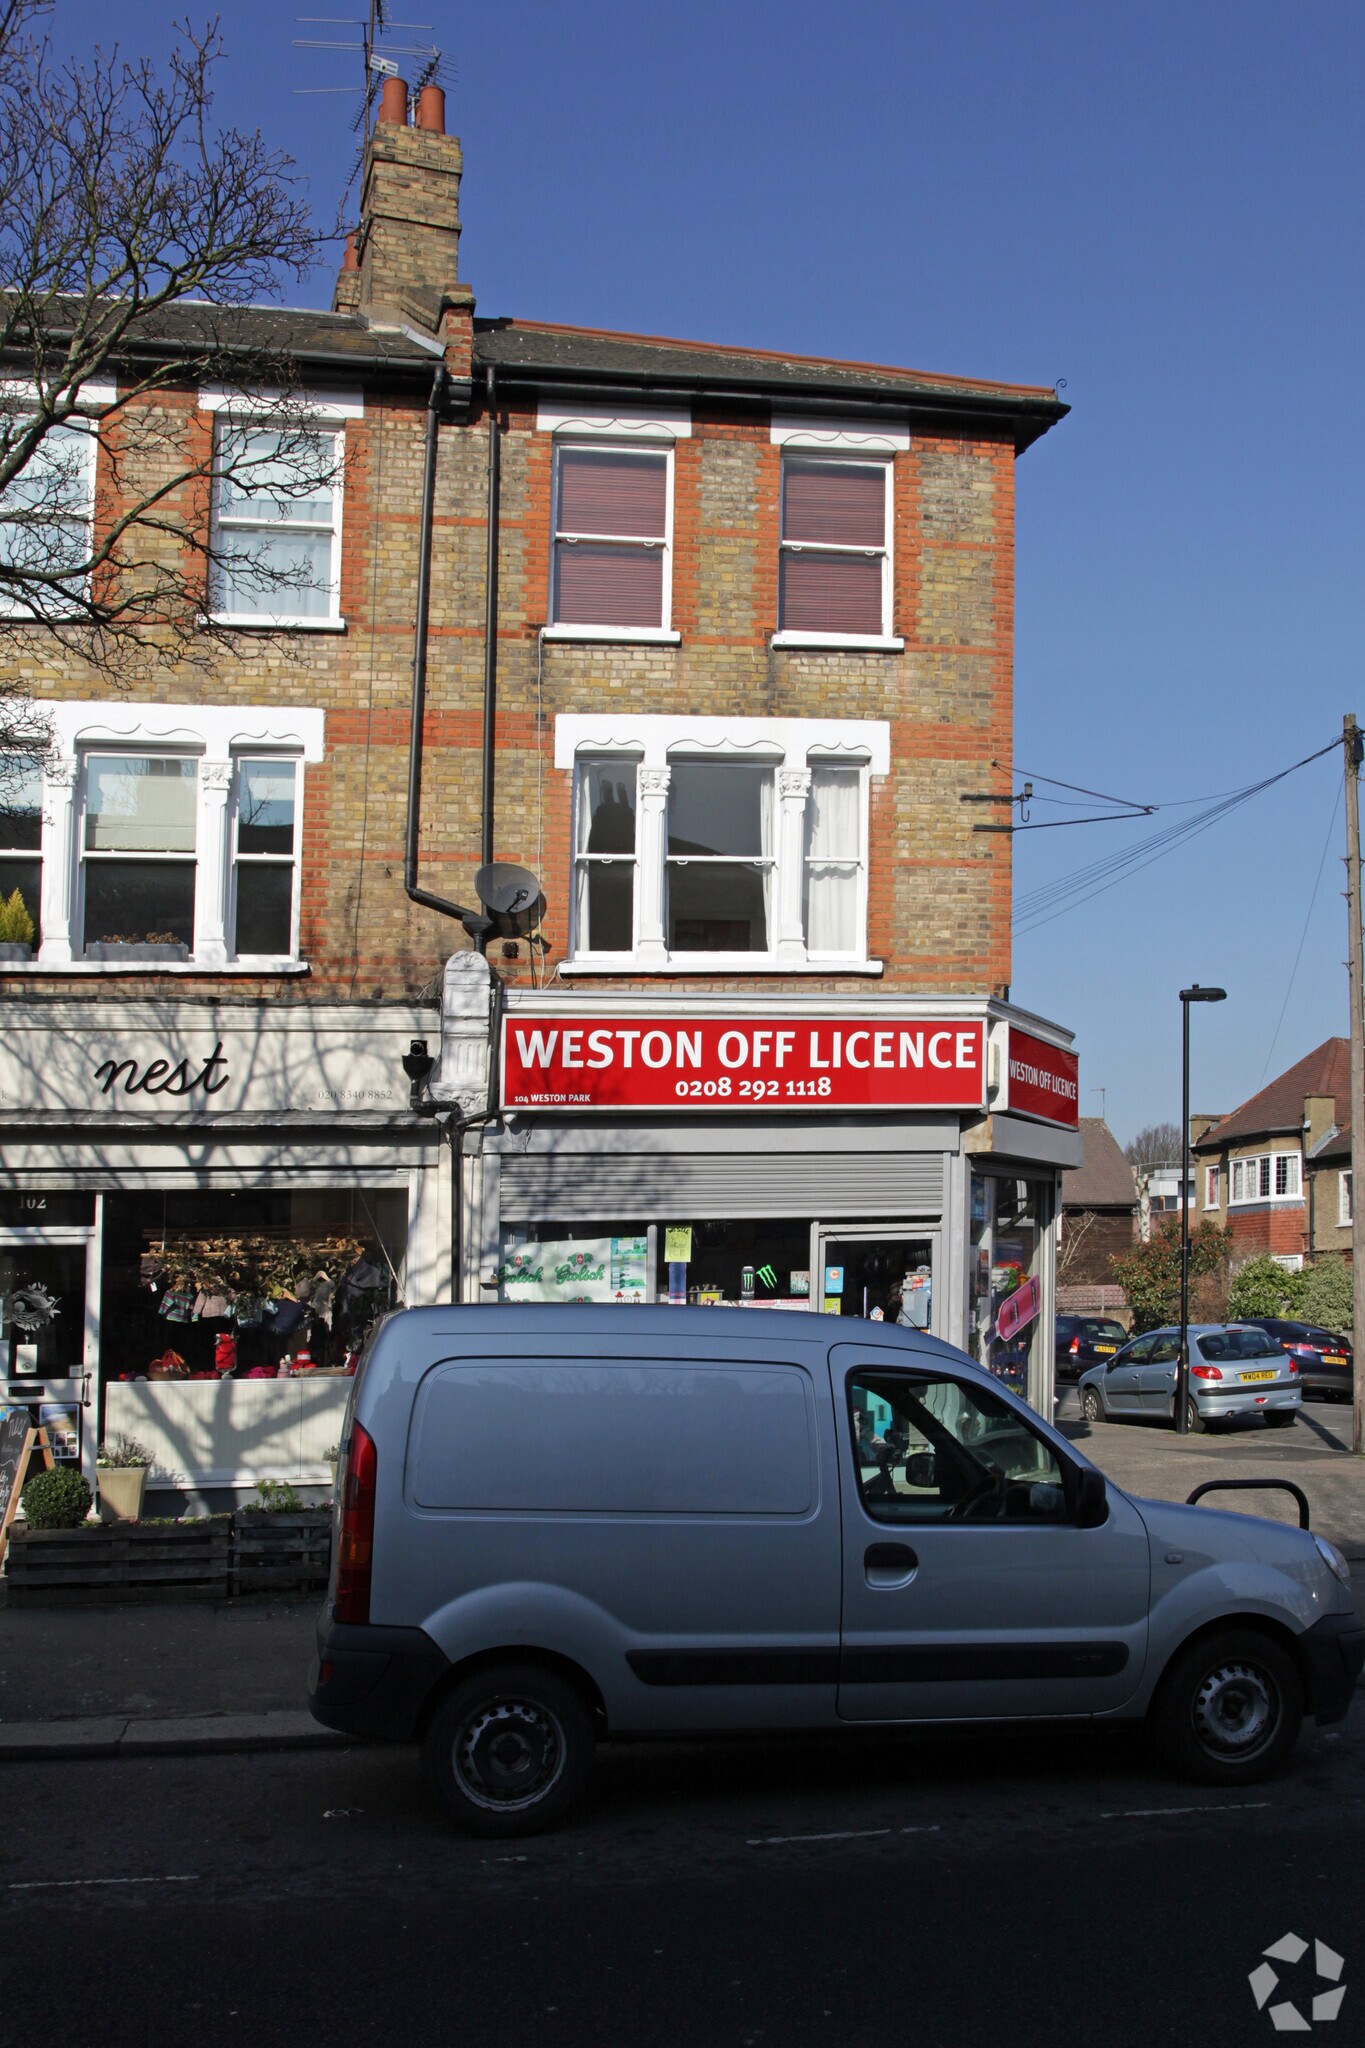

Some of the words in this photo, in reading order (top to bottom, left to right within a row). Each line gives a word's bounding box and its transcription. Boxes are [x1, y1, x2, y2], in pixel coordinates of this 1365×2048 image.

[515, 1030, 702, 1069] WESTON
[717, 1030, 796, 1069] OFF
[809, 1031, 976, 1069] LICENCE
[94, 1041, 230, 1096] nest
[1009, 1058, 1038, 1087] WESTON
[1039, 1070, 1051, 1091] OFF
[1052, 1075, 1077, 1100] LICENCE
[318, 1090, 337, 1100] 020
[340, 1090, 365, 1100] 8340
[367, 1090, 392, 1100] 8852
[514, 1095, 529, 1104] 104
[530, 1094, 566, 1103] WESTON
[568, 1094, 591, 1103] PARK
[675, 1077, 732, 1097] 0208
[739, 1080, 779, 1101] 292
[785, 1076, 831, 1096] 1118
[18, 1195, 47, 1209] 102
[554, 1264, 606, 1286] Grolsch
